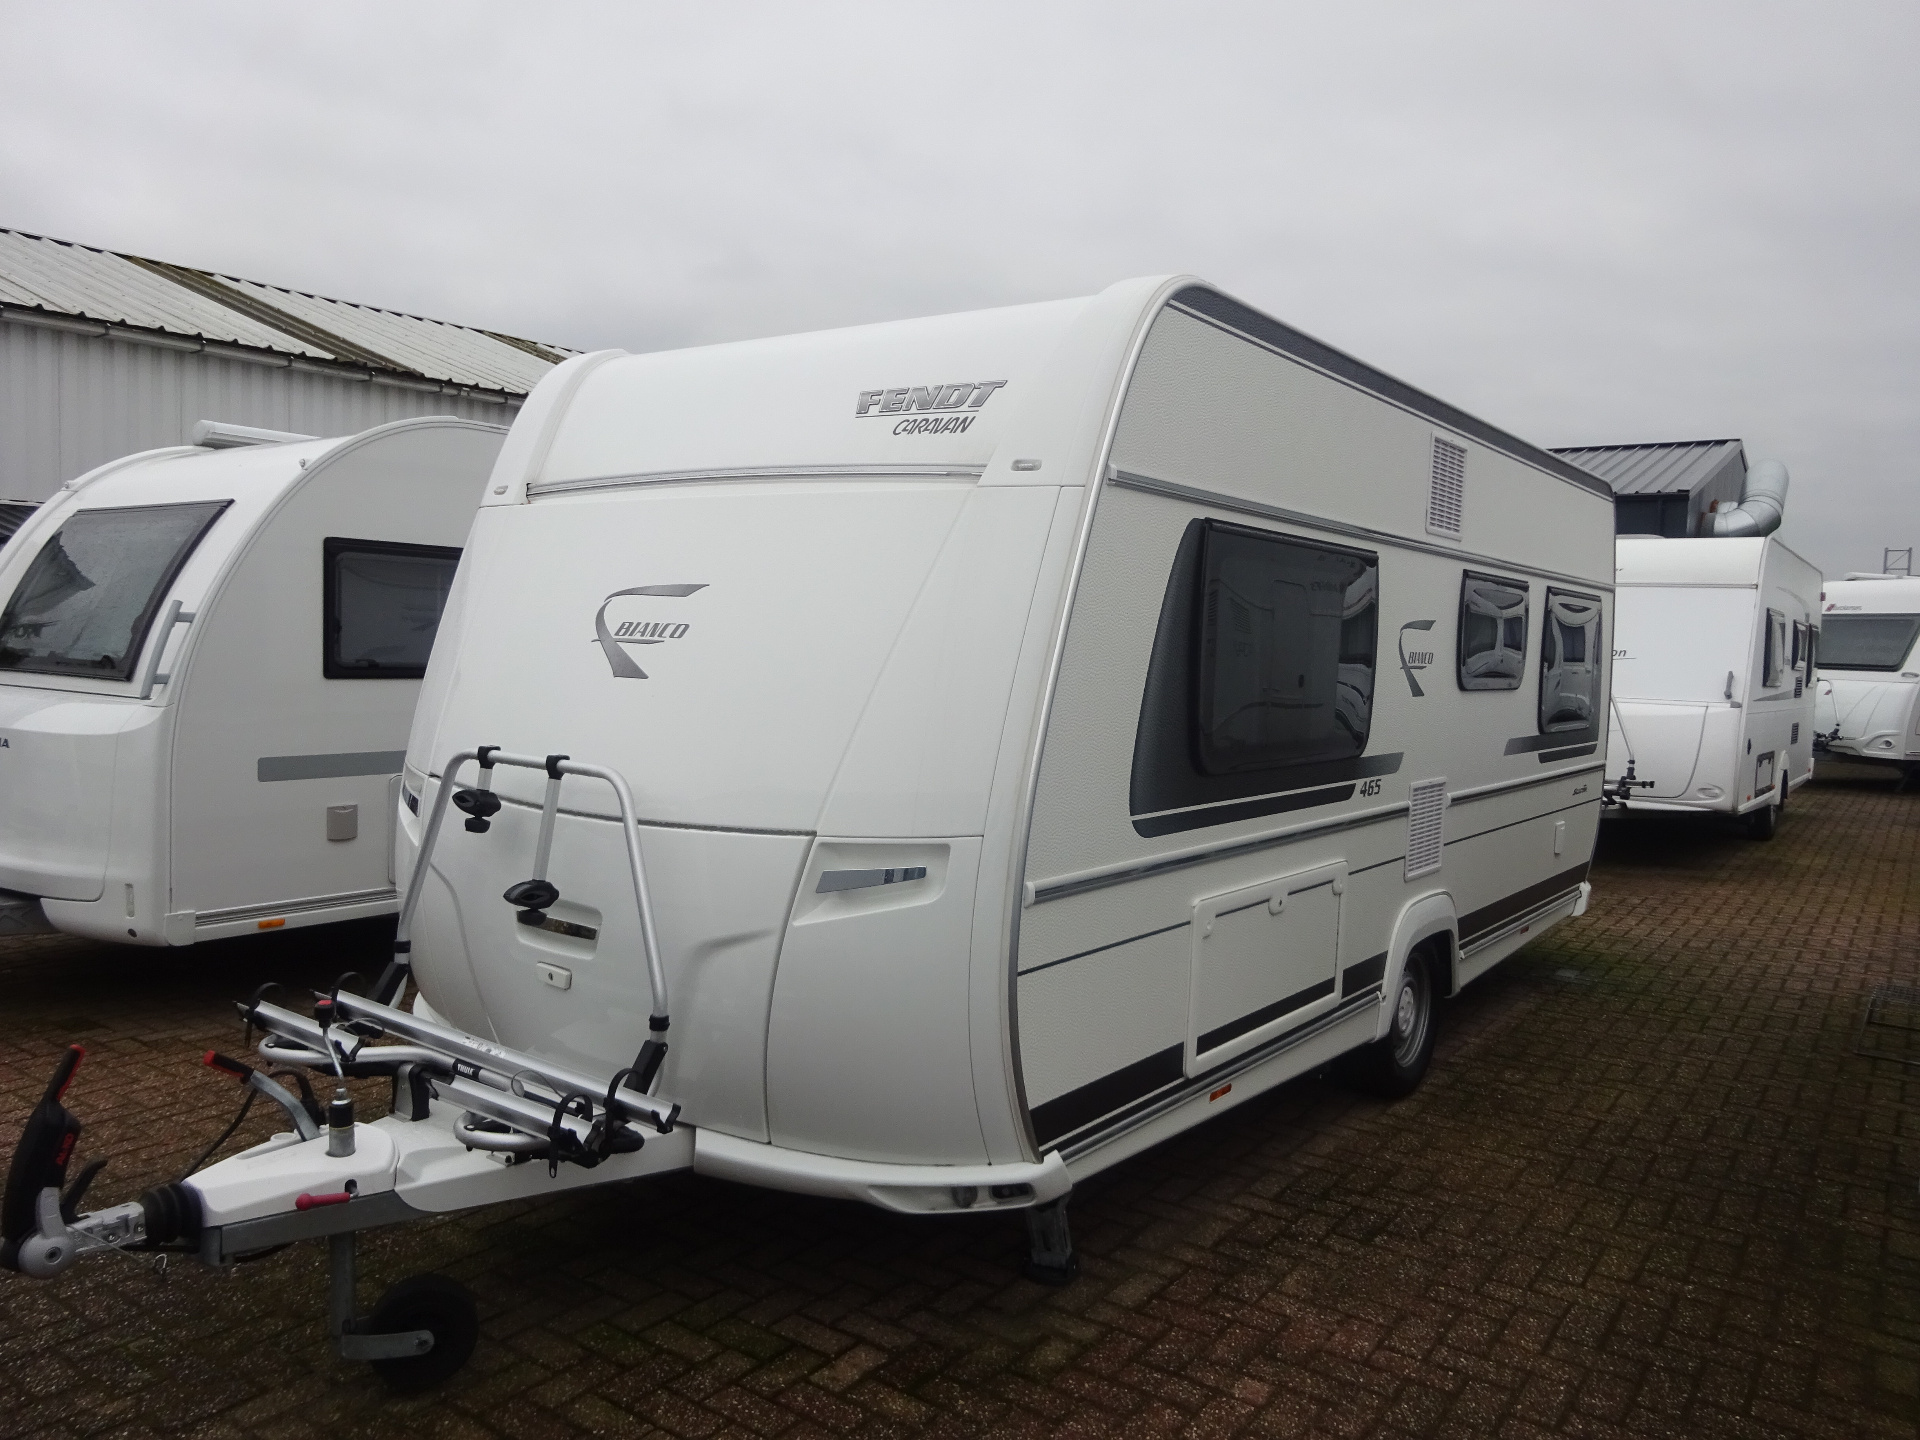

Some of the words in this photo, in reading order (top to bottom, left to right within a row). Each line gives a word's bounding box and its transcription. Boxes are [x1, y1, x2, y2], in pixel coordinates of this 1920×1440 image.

[856, 380, 1008, 414] FENDT
[893, 416, 976, 436] CARAVAN
[614, 621, 690, 639] BIANCO
[1360, 778, 1382, 797] 465
